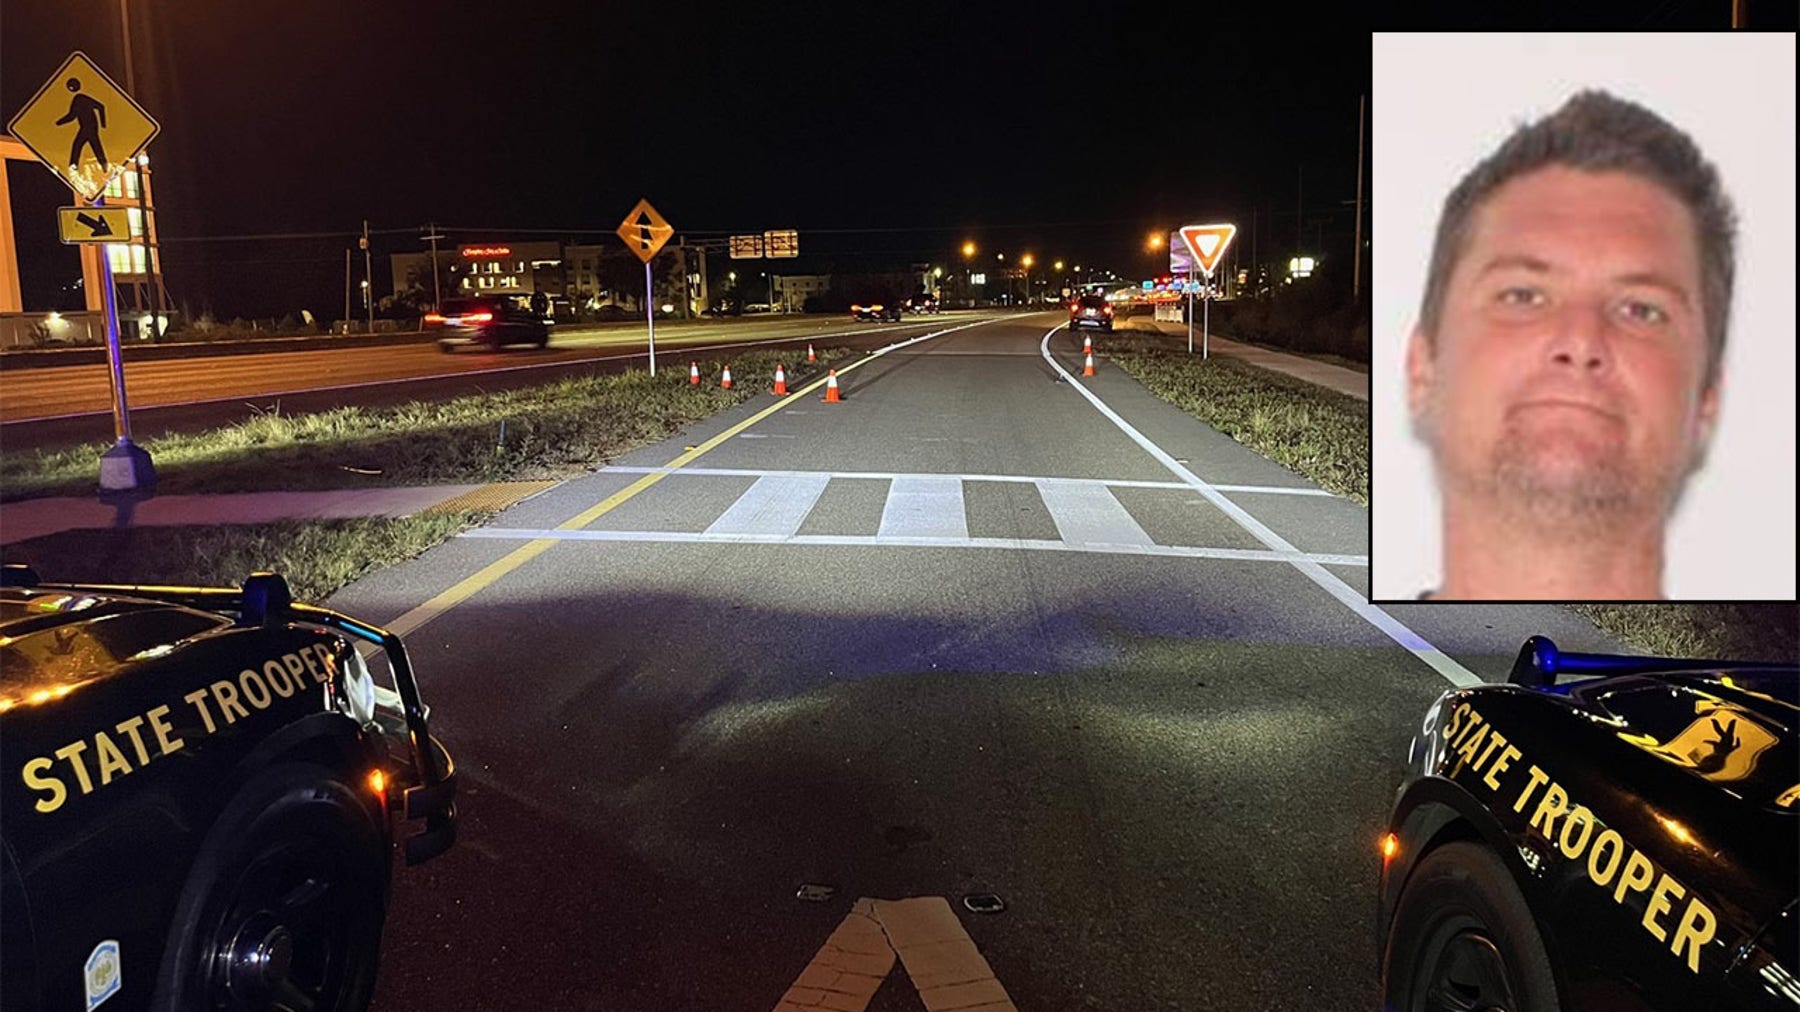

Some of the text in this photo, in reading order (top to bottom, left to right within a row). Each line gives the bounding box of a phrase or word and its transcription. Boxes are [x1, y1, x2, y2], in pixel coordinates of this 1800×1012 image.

[22, 641, 340, 813] STATE TROOPER
[1443, 702, 1718, 974] STATE TROOPER
